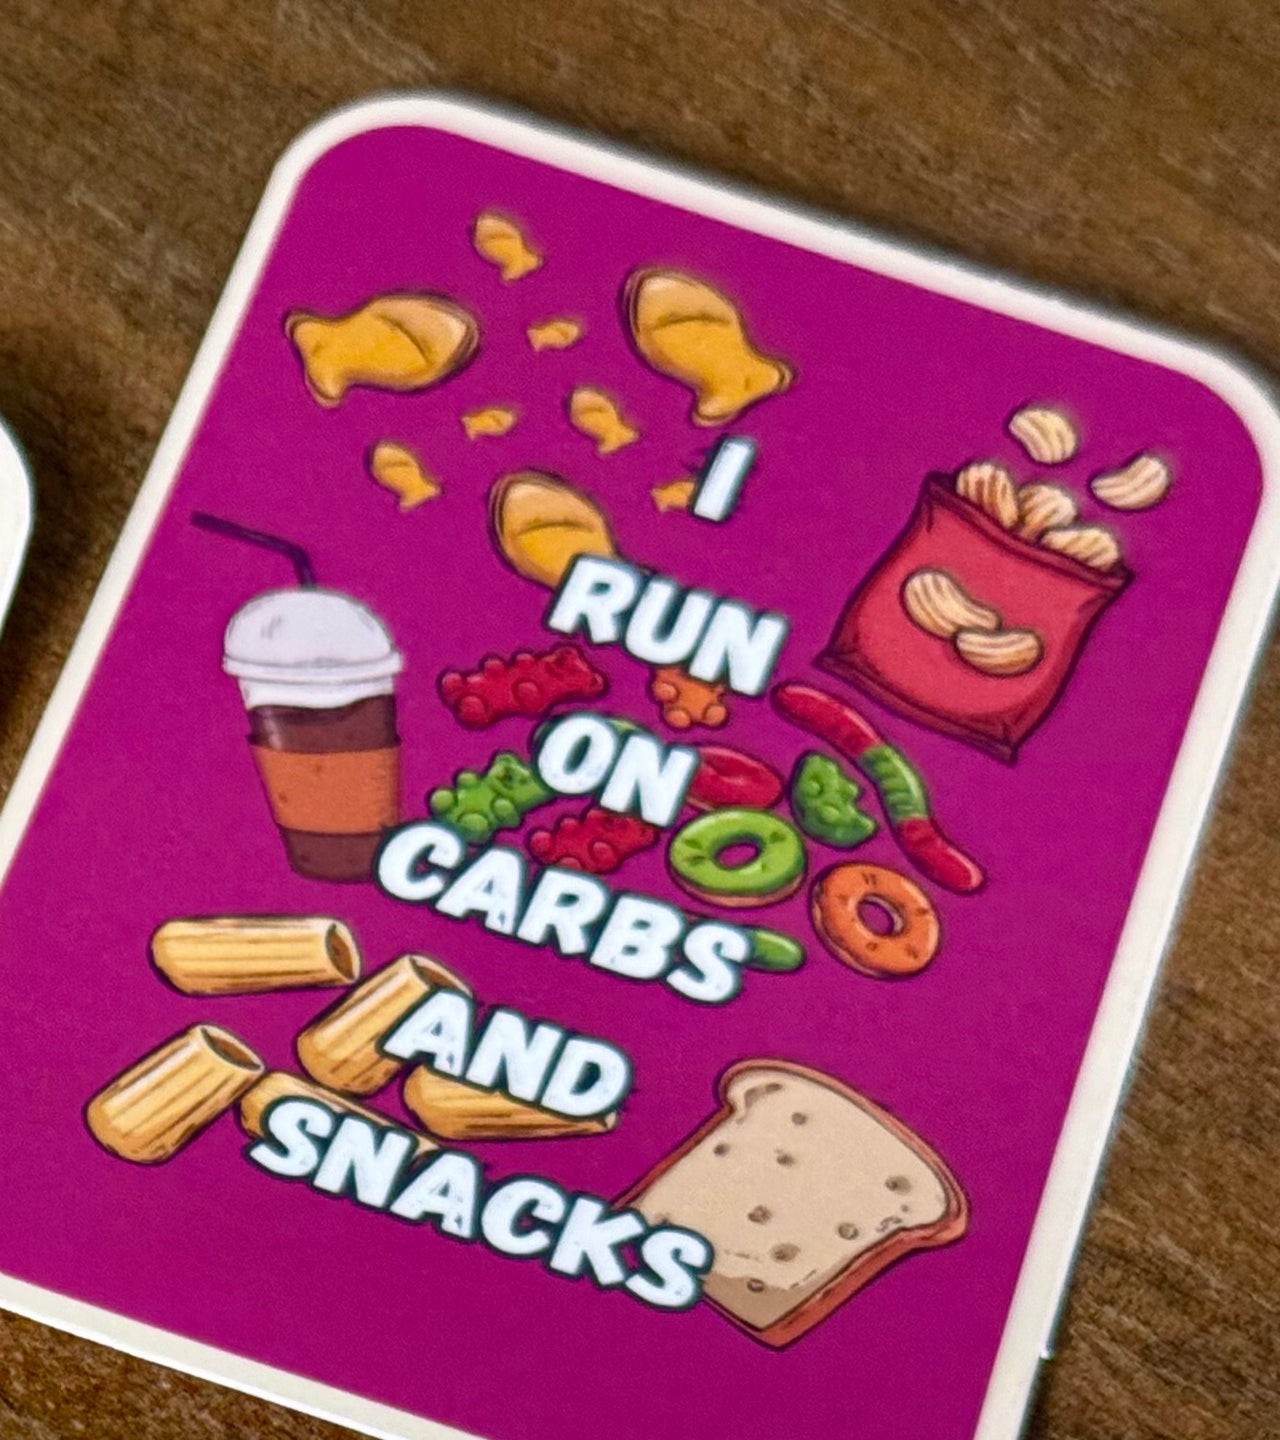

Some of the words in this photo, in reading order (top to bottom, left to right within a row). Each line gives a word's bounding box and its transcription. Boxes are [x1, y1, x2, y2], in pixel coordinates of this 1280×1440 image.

[695, 442, 751, 519] I
[550, 559, 784, 694] RUN
[539, 717, 694, 825] ON
[379, 825, 748, 1000] CARBS
[385, 992, 627, 1115] AND
[251, 1102, 706, 1305] SNACKS
